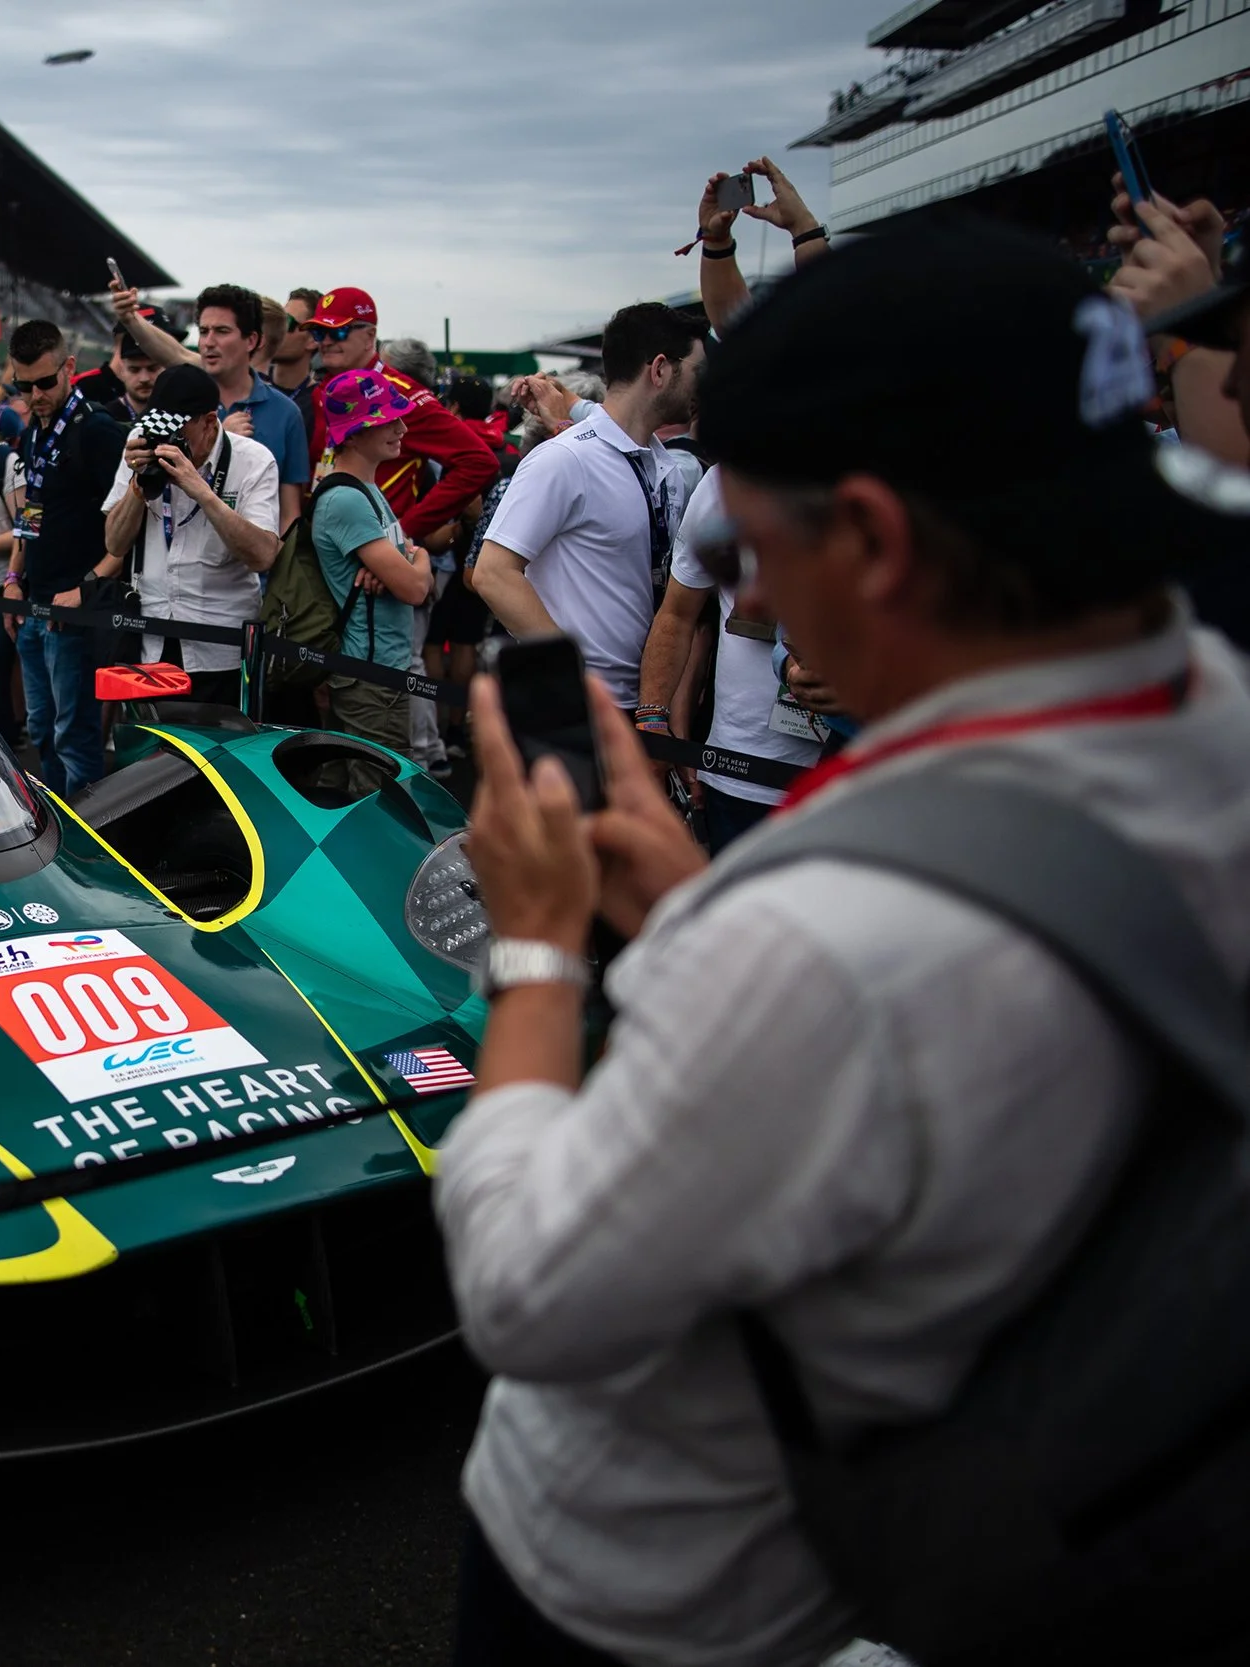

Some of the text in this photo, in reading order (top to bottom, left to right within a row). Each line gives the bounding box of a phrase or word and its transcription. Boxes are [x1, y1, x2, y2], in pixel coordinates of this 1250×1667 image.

[423, 687, 437, 695] RACING
[780, 719, 798, 728] ASTON
[789, 727, 808, 736] LISBOA
[718, 755, 750, 768] THE HEART
[726, 763, 749, 774] RACING
[62, 951, 119, 961] TotalEnergies
[11, 966, 190, 1055] 009
[103, 1038, 195, 1070] WEC
[127, 1066, 156, 1075] WORLD
[158, 1057, 205, 1069] ENDURANCE
[115, 1067, 177, 1082] CHAMPIONSHIP
[33, 1064, 333, 1149] THE HEART
